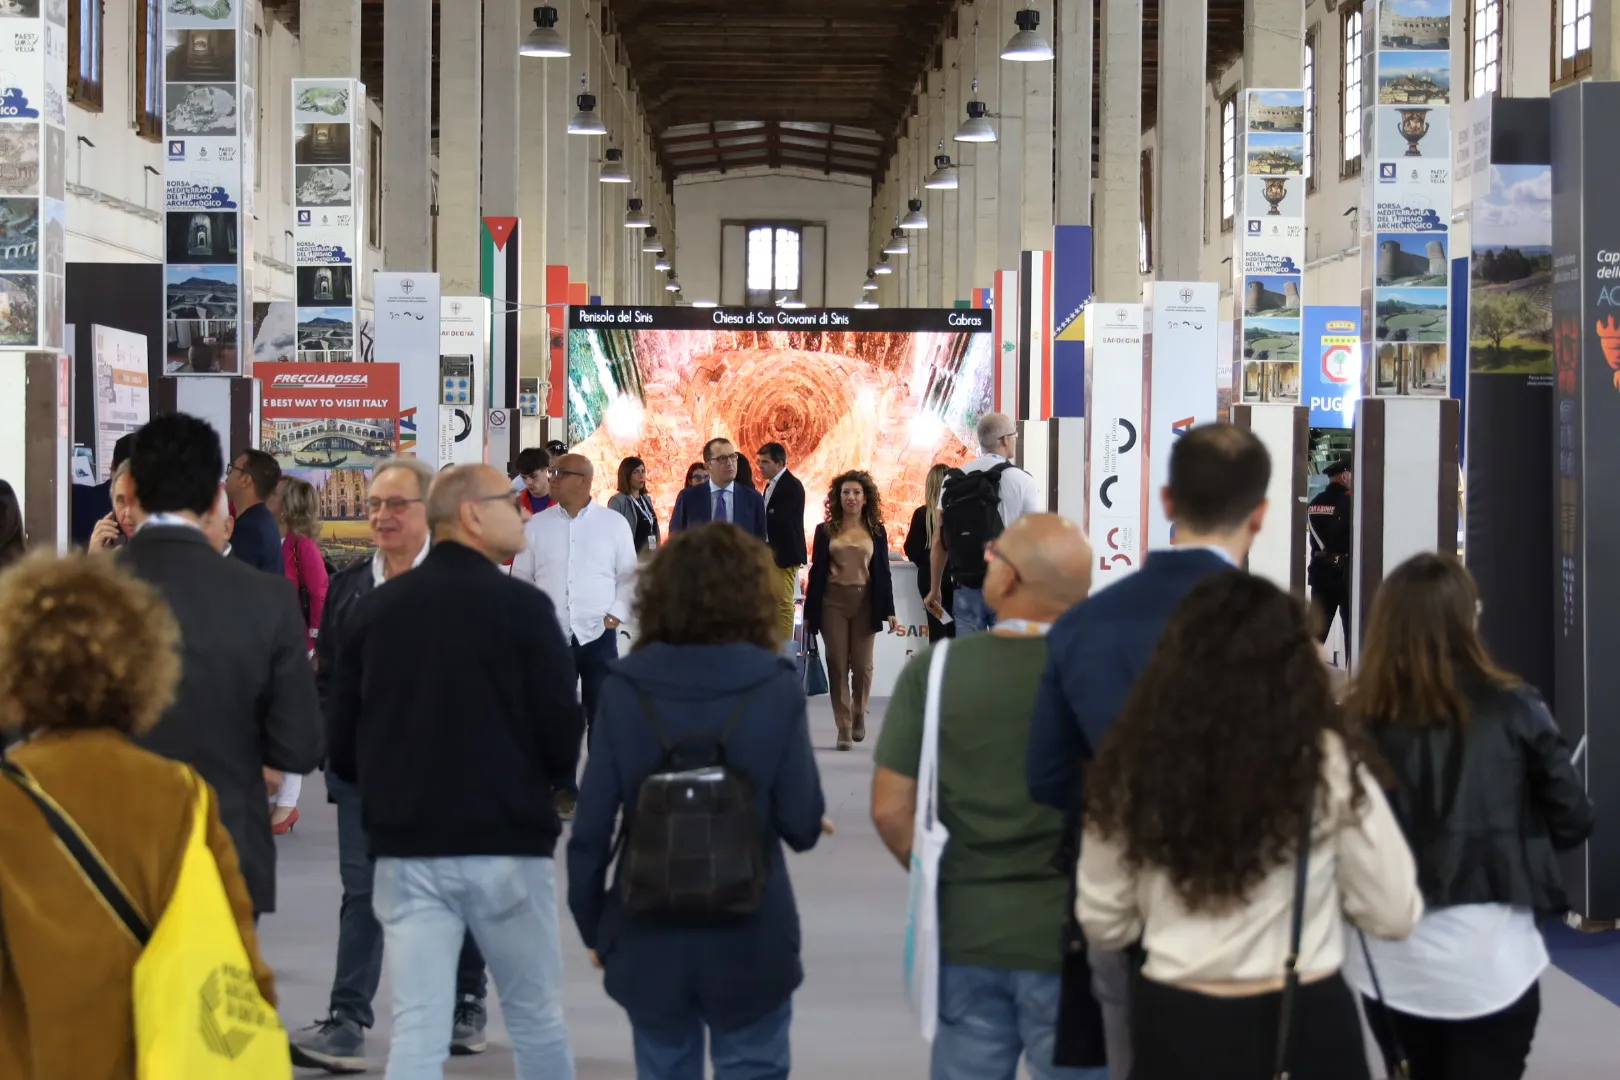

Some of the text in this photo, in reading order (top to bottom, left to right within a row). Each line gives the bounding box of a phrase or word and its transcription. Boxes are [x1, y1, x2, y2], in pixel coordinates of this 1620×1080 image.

[580, 310, 653, 323] Penisola del Sinis
[713, 311, 849, 325] Chiesa di San Giovanni di Sinis
[948, 313, 982, 326] Cabras
[273, 374, 368, 383] FRECCIAROSSA
[270, 399, 293, 407] BEST
[294, 399, 318, 407] WAY
[320, 399, 334, 407] TO
[336, 399, 361, 407] VISIT
[362, 399, 389, 407] ITALY
[1310, 397, 1343, 412] PUG
